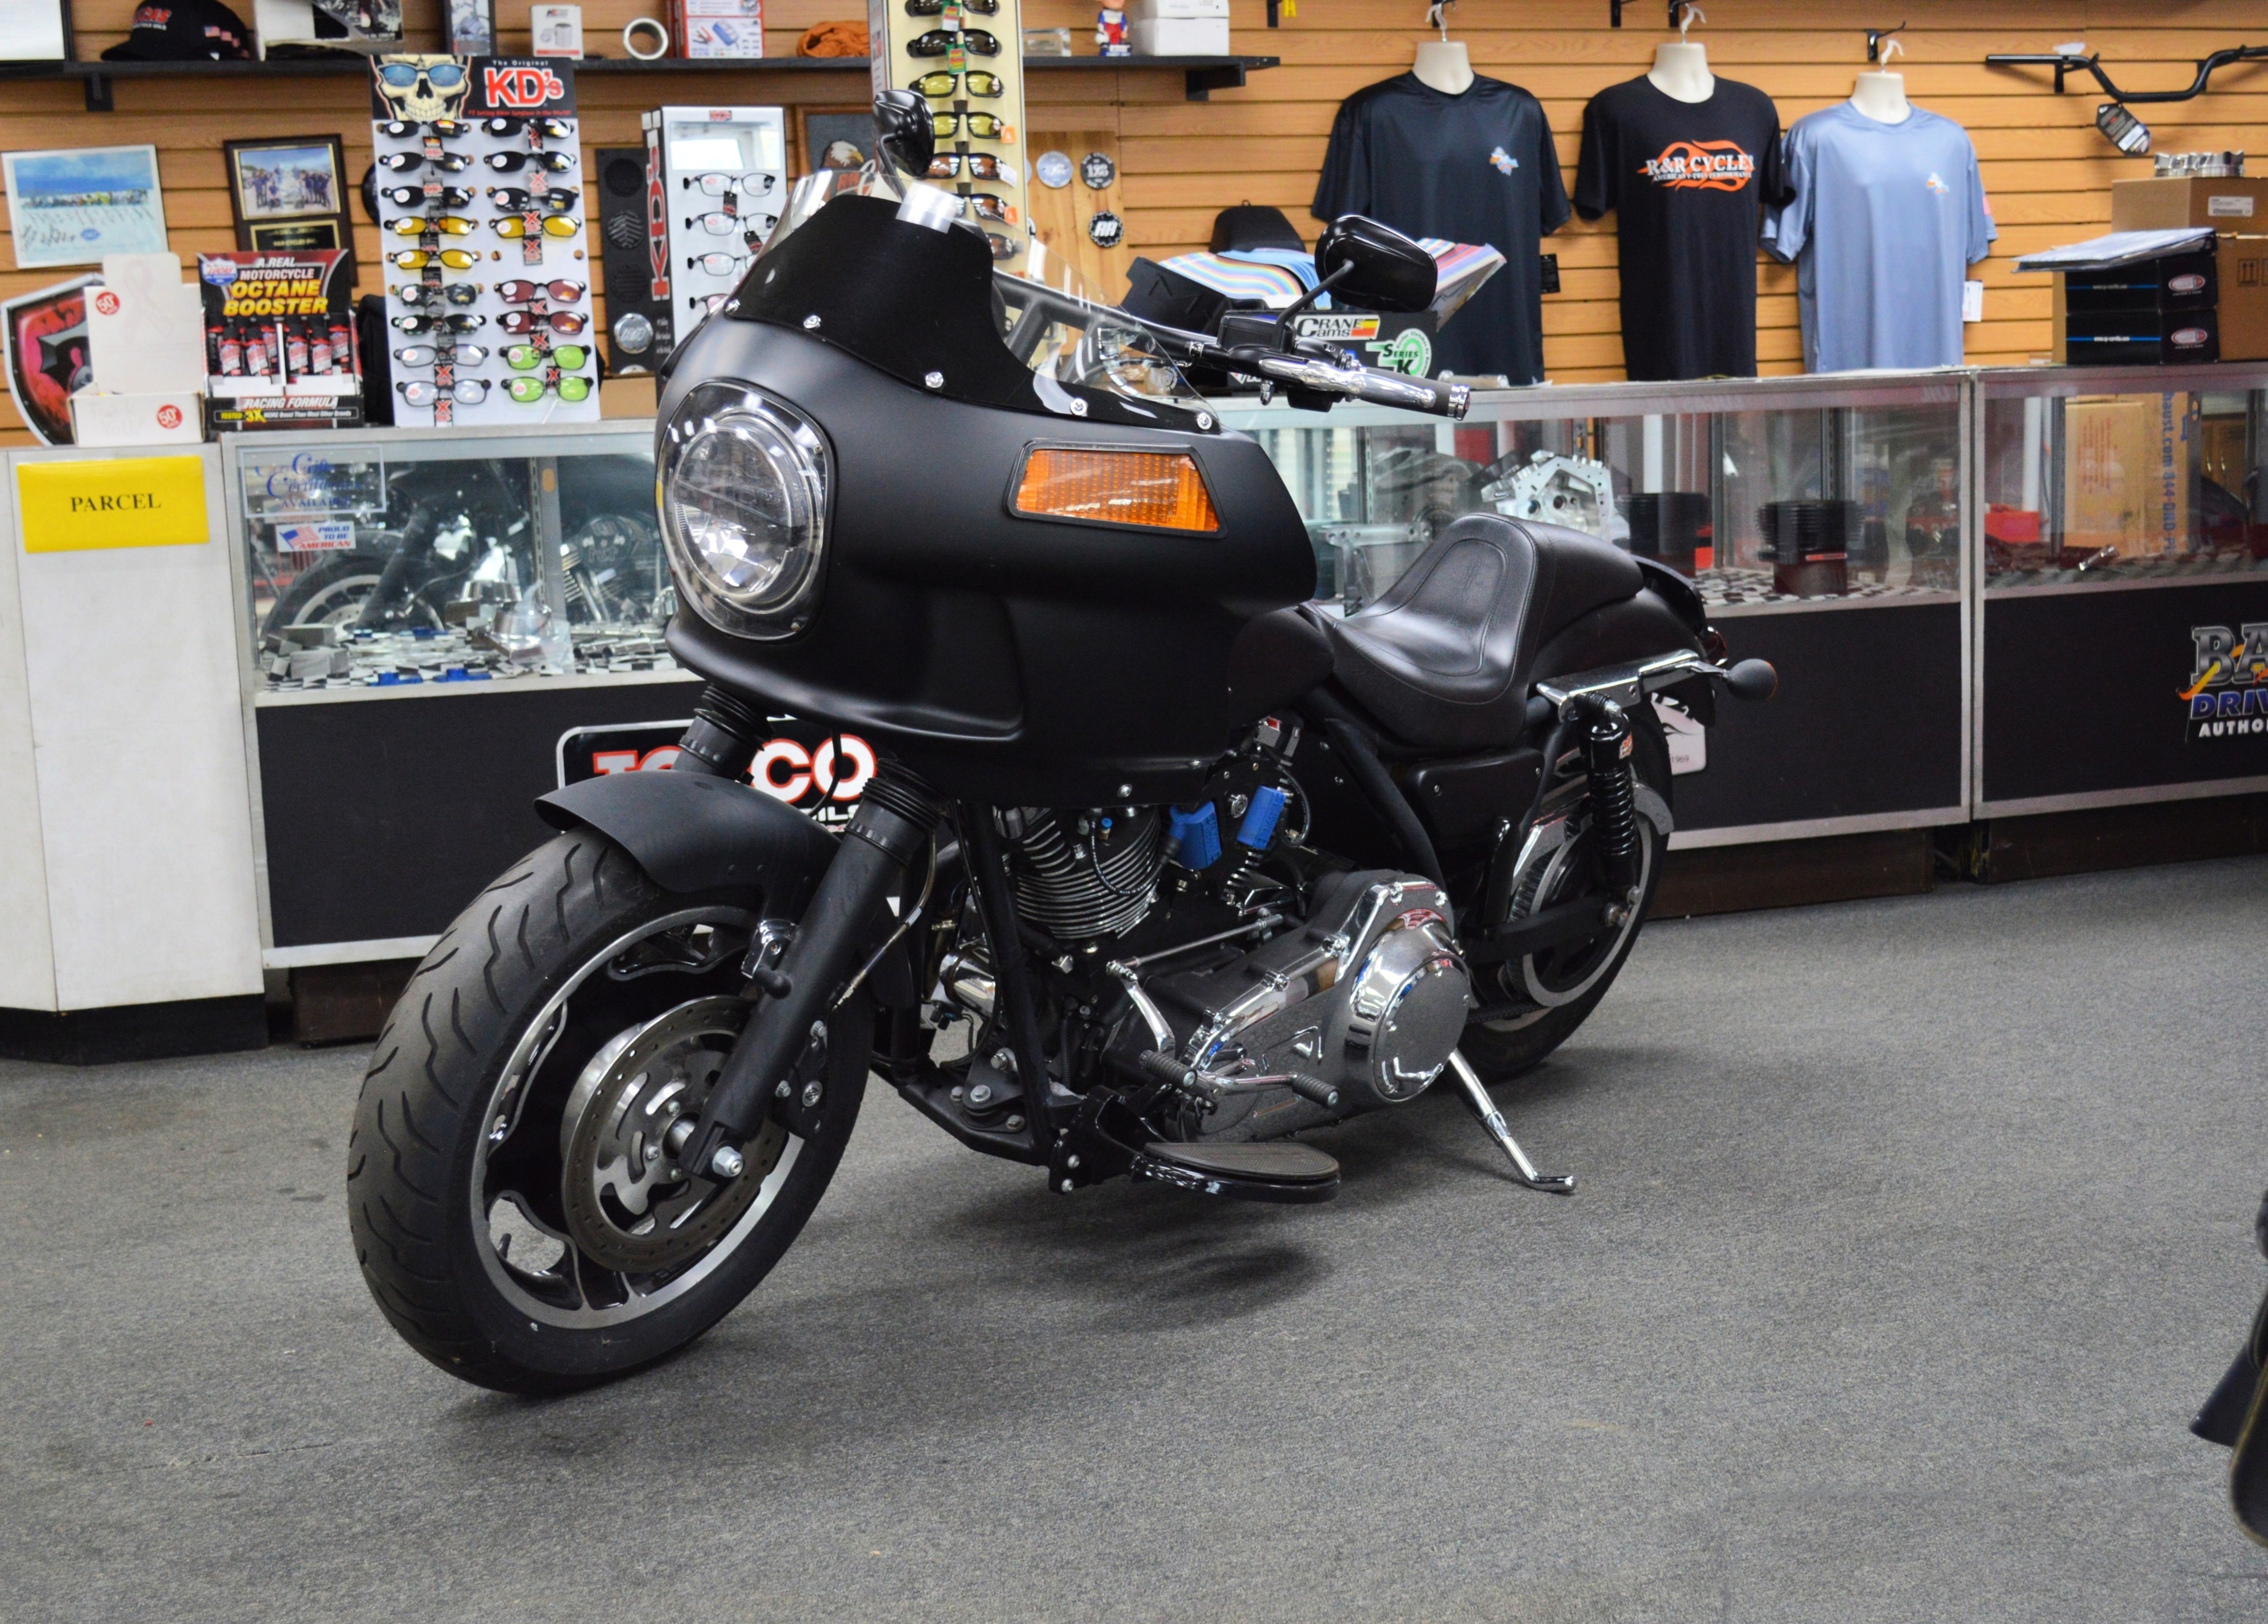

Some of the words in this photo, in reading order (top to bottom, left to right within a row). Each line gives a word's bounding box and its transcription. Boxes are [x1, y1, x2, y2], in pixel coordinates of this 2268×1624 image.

[484, 67, 565, 107] KD's
[1646, 156, 1686, 176] R&R
[646, 146, 669, 301] KD's
[258, 258, 265, 268] A
[267, 257, 296, 268] REAL
[239, 269, 315, 280] MOTORCYCLE
[231, 279, 322, 299] OCTANE
[223, 297, 329, 317] BOOSTER
[1297, 318, 1364, 337] CRANE
[1382, 343, 1418, 358] SERIES
[1396, 359, 1414, 375] K
[243, 397, 287, 409] RACING
[287, 396, 338, 408] FORMULA
[245, 409, 268, 423] 3X
[71, 493, 162, 512] PARCEL
[299, 541, 351, 550] AMERICAN
[2198, 719, 2268, 738] AUTHO
